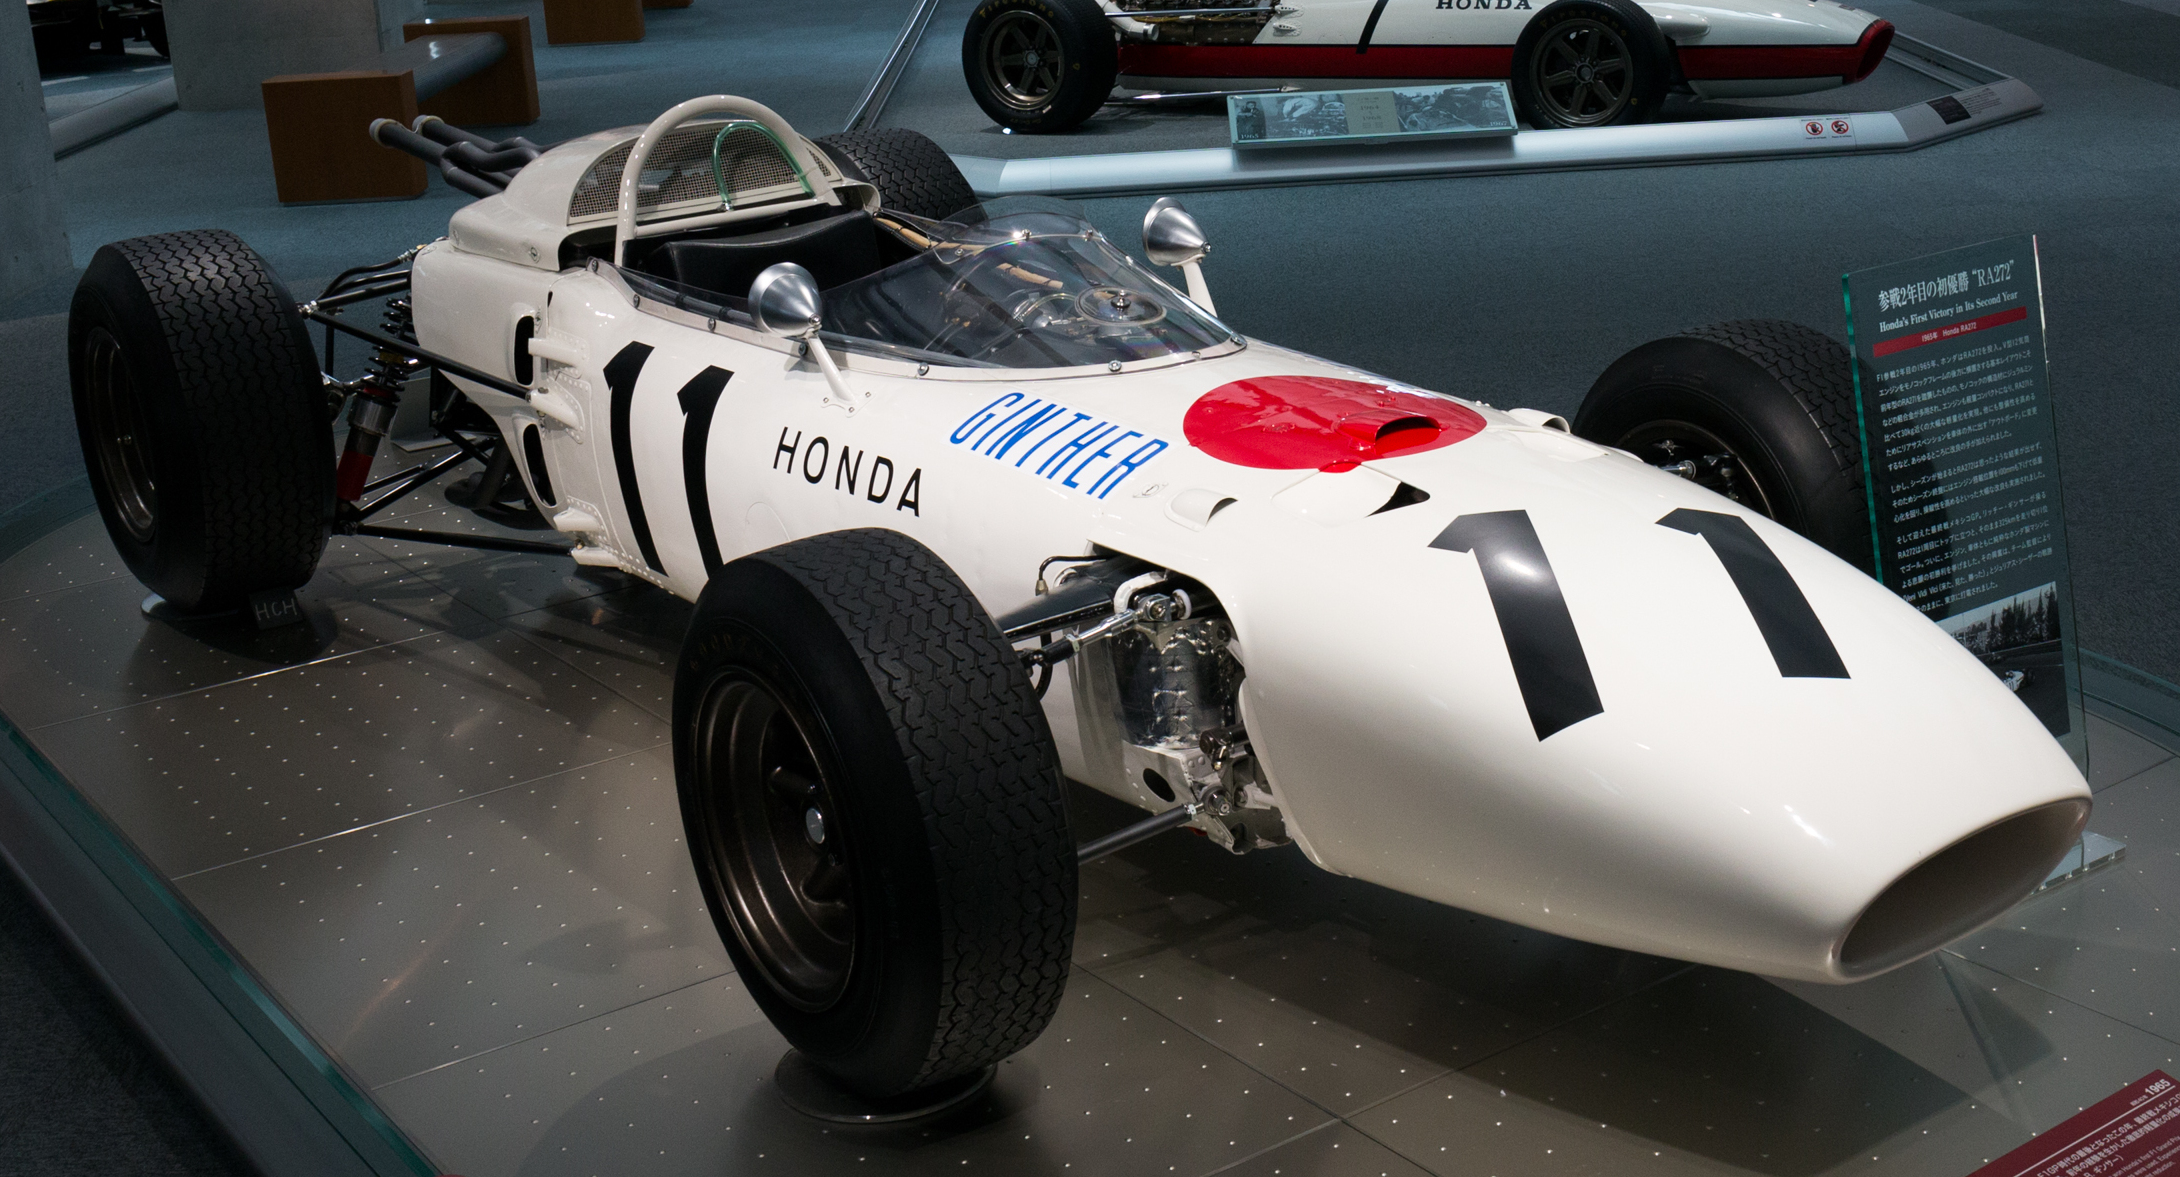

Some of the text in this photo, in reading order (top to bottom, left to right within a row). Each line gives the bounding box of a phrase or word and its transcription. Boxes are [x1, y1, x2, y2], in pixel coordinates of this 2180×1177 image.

[1435, 0, 1532, 10] HONDA
[1877, 271, 1969, 313] 参戦2年目の初優勝
[1879, 291, 2018, 333] Honda's First Victory in Its Second Year
[1921, 322, 1977, 342] 1965年 Honda RA272
[603, 341, 735, 580] 11
[949, 392, 1169, 500] GINTHER
[773, 426, 922, 518] HONDA
[255, 598, 297, 621] HCH
[2144, 1078, 2171, 1095] 1965
